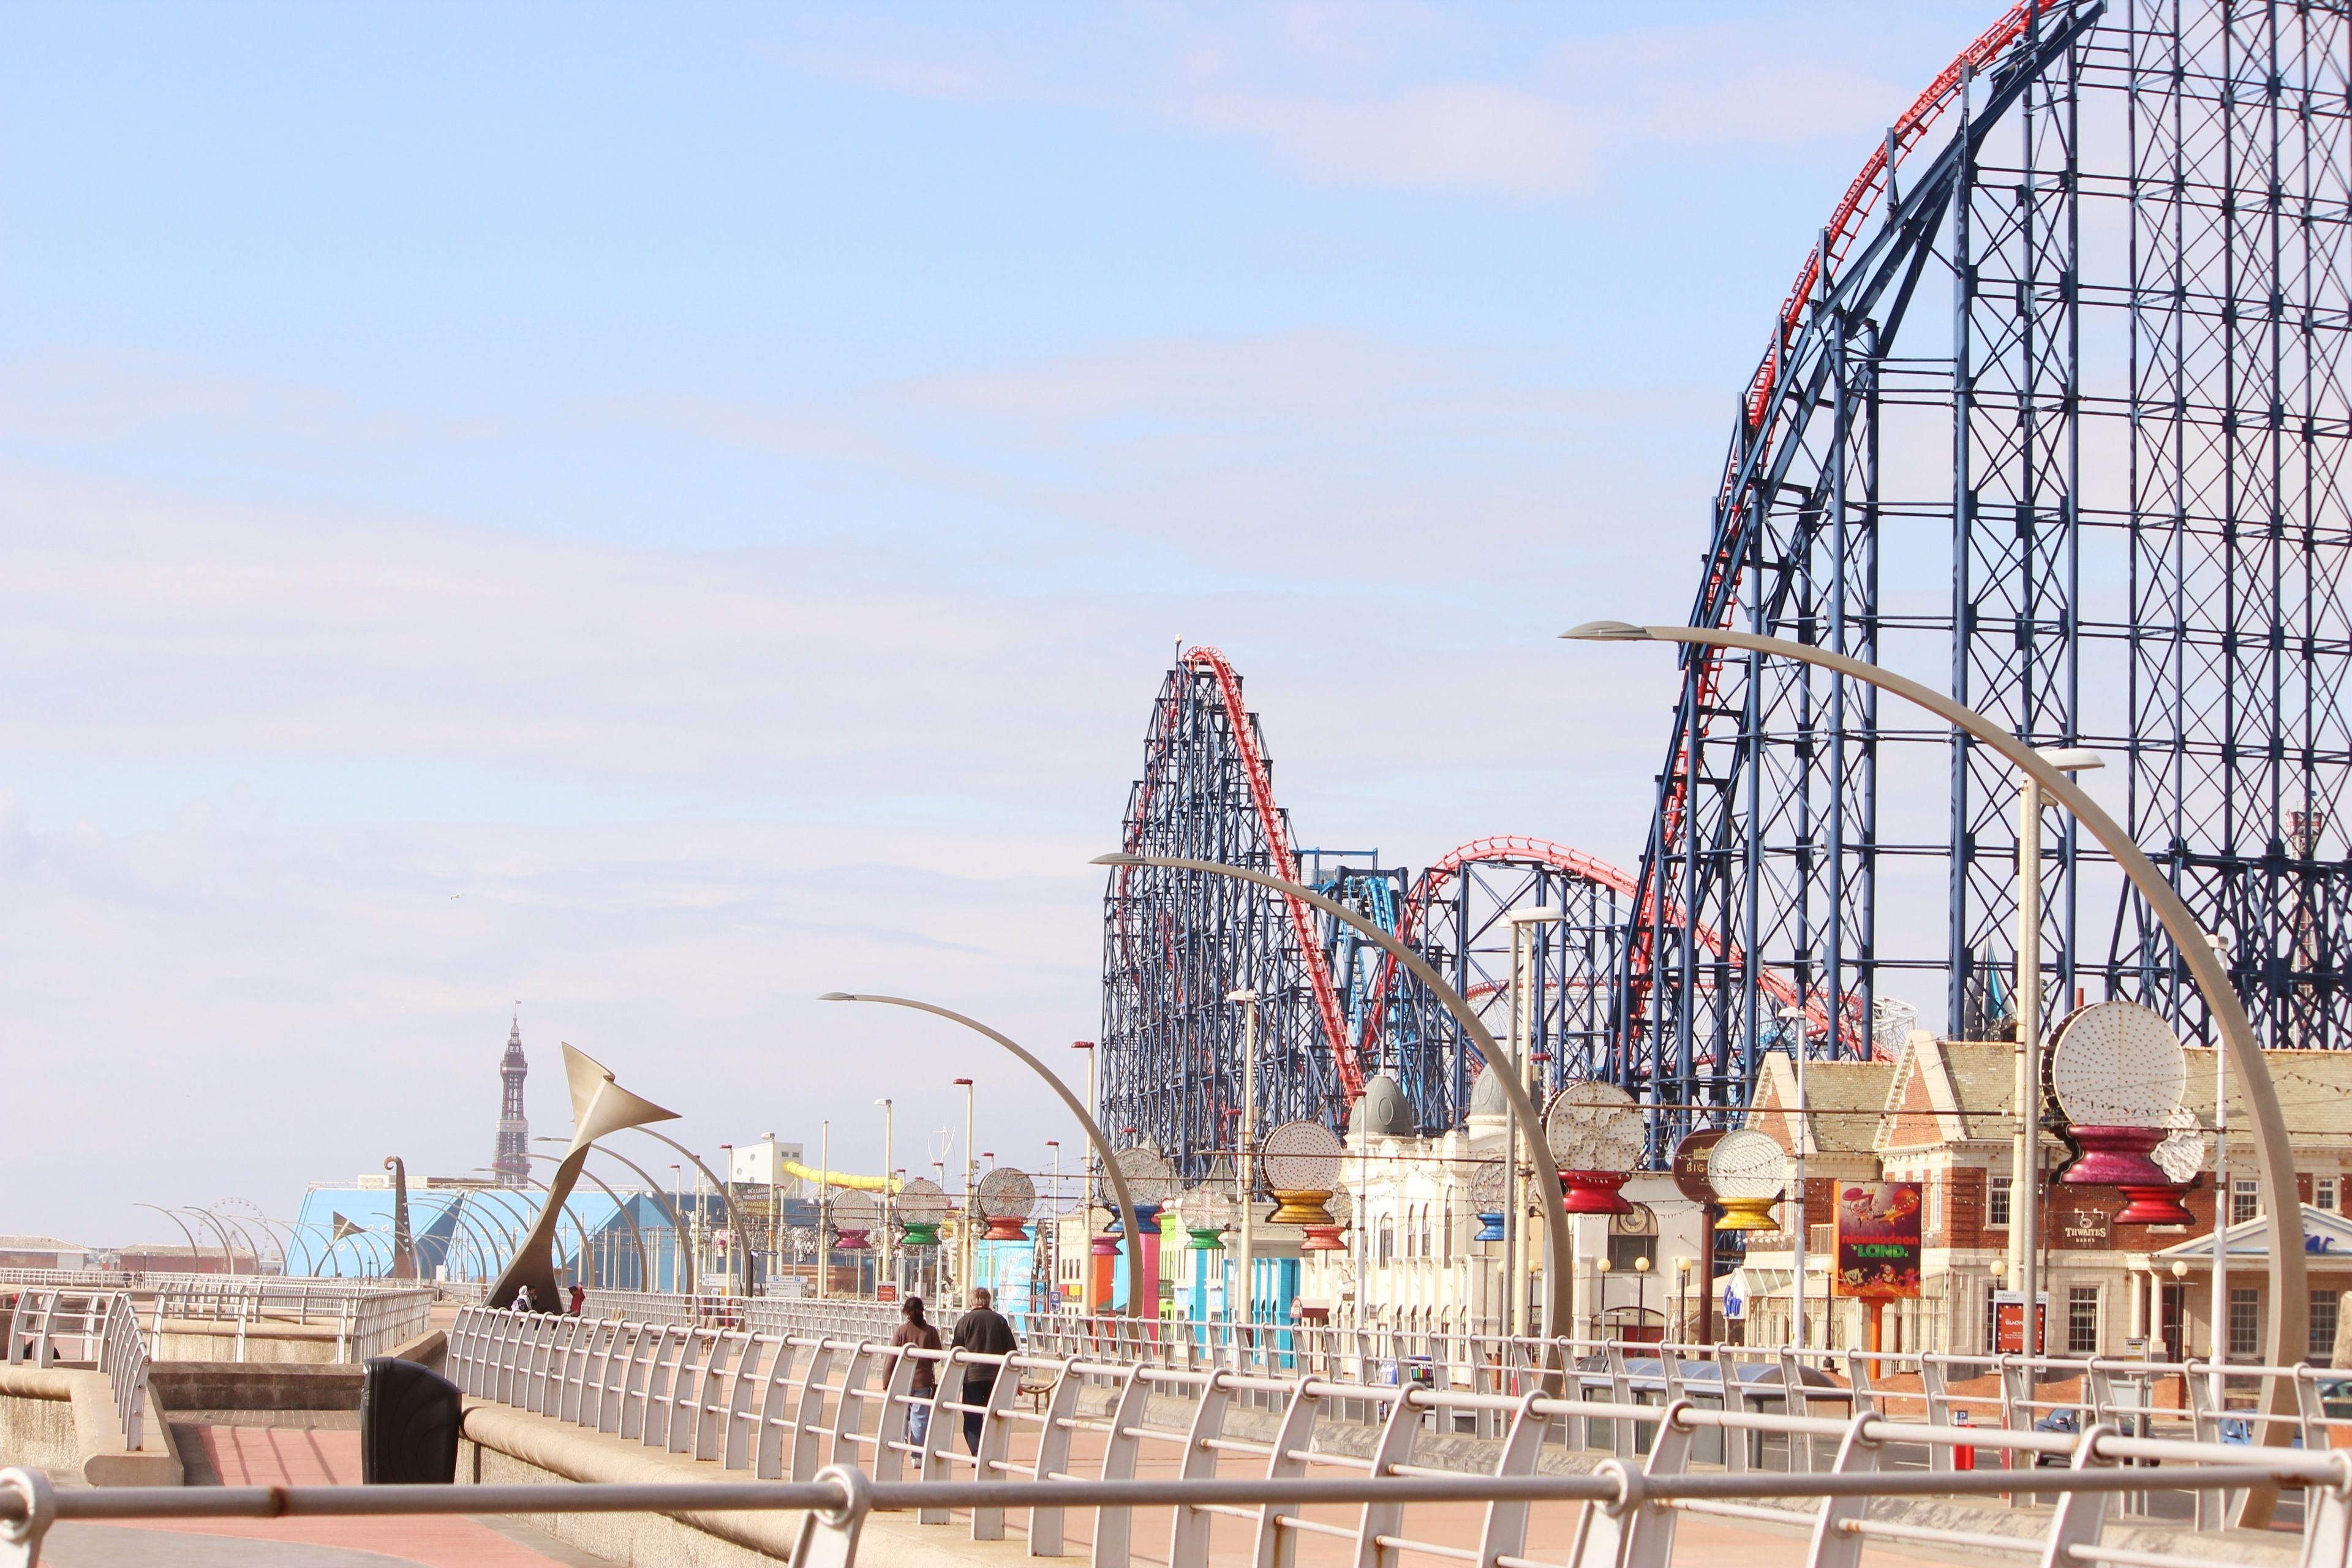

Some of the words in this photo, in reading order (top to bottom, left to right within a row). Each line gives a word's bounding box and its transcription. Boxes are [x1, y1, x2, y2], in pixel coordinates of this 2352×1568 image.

[1842, 1232, 1918, 1245] nickelodeon
[2065, 1227, 2106, 1237] THWAITES
[1858, 1244, 1905, 1258] LAND
